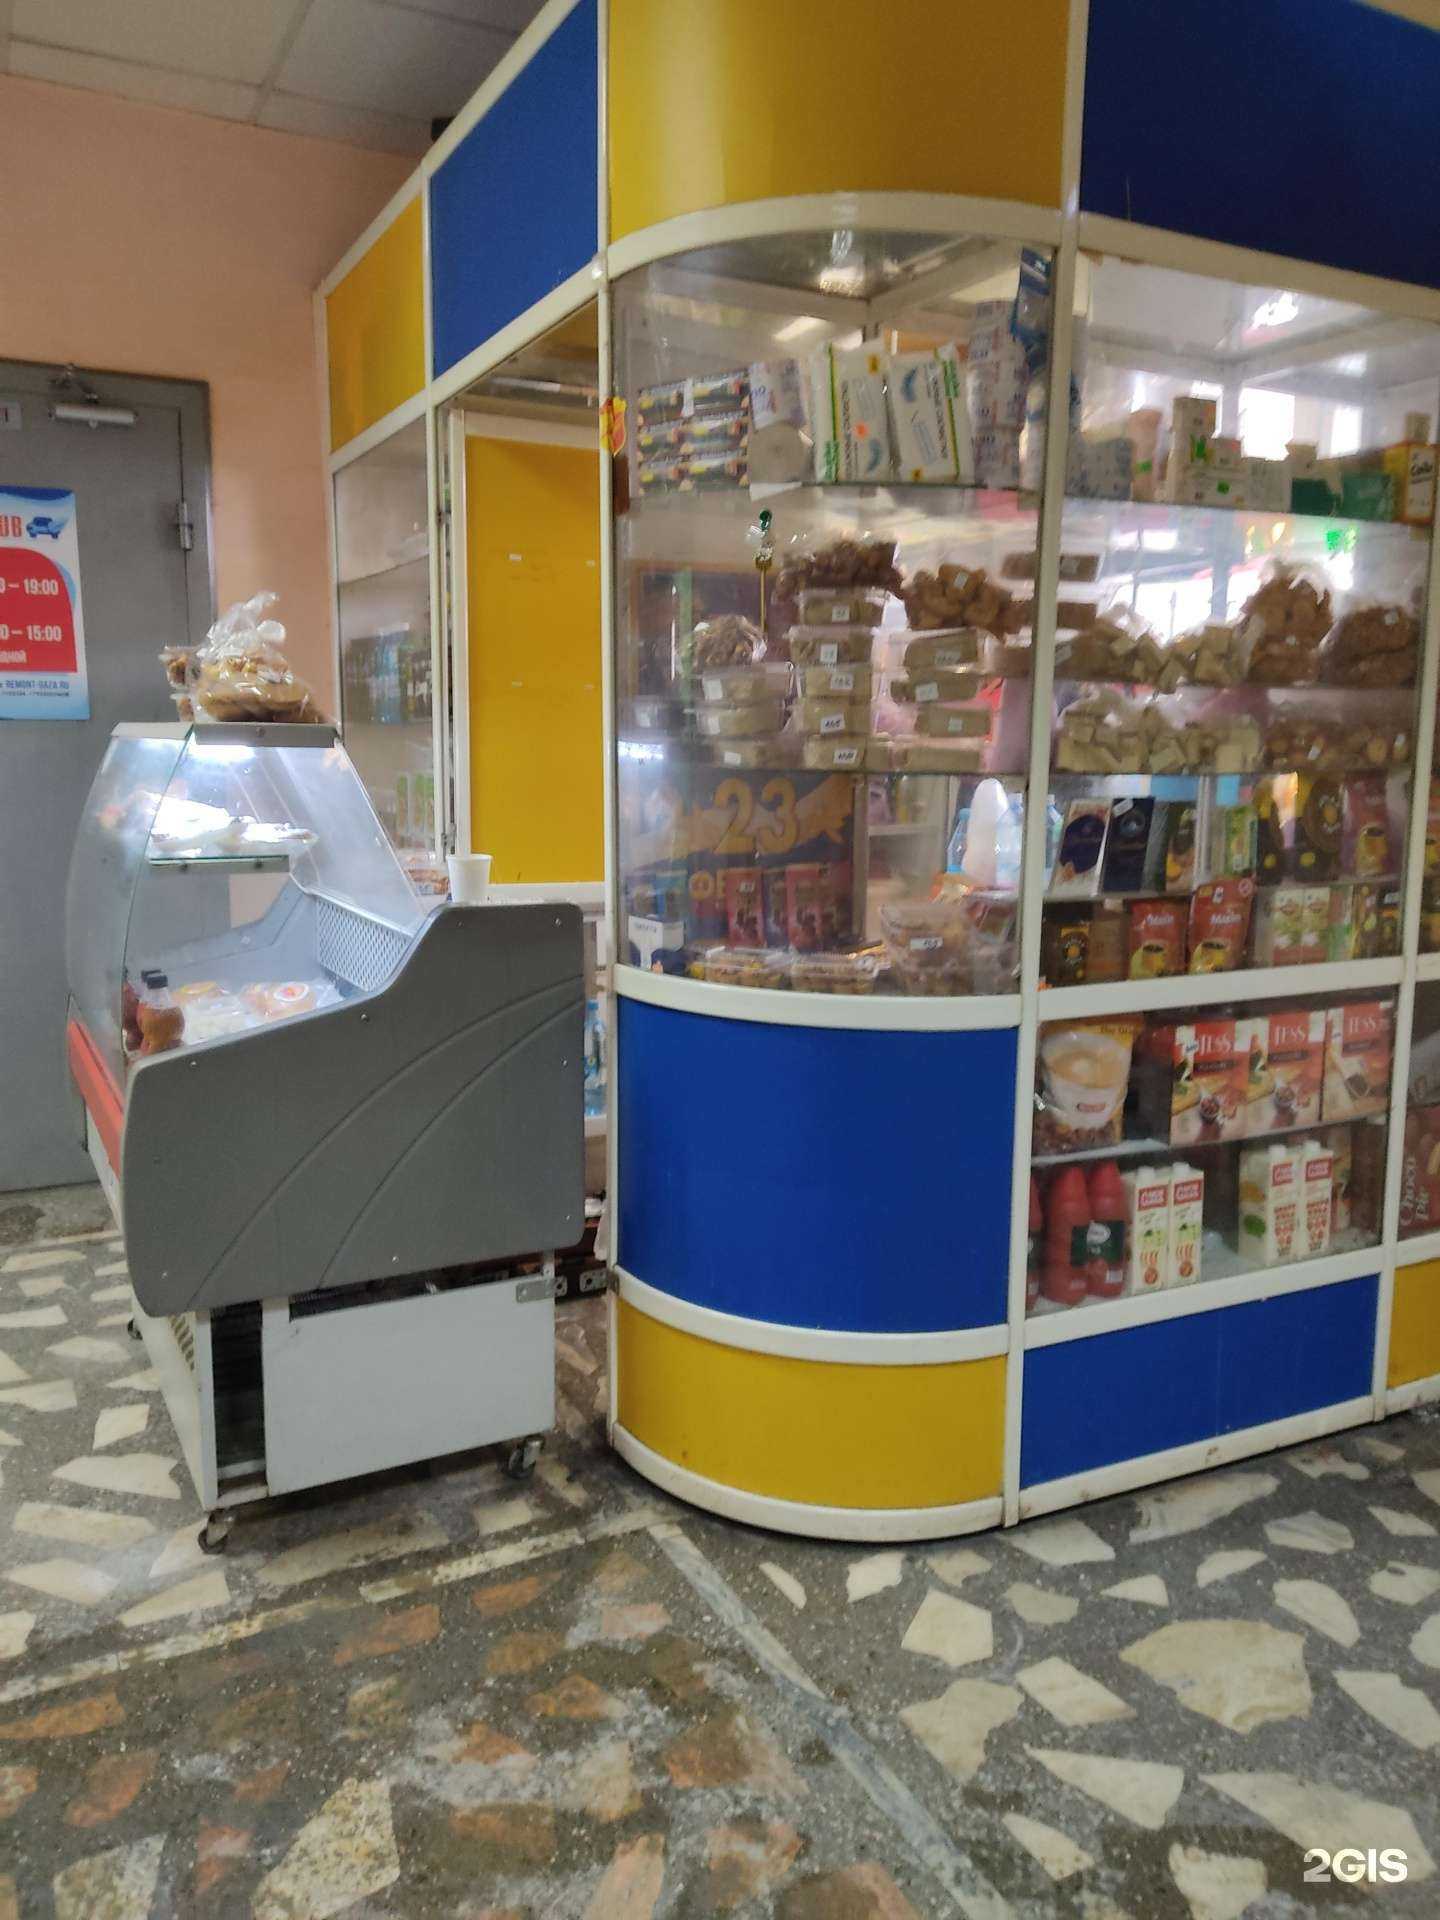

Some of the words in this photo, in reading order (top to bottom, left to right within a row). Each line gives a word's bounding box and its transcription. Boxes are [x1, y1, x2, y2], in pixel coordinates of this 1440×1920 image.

[24, 579, 59, 595] 19:00
[26, 625, 62, 641] 15:00
[714, 777, 796, 855] 23
